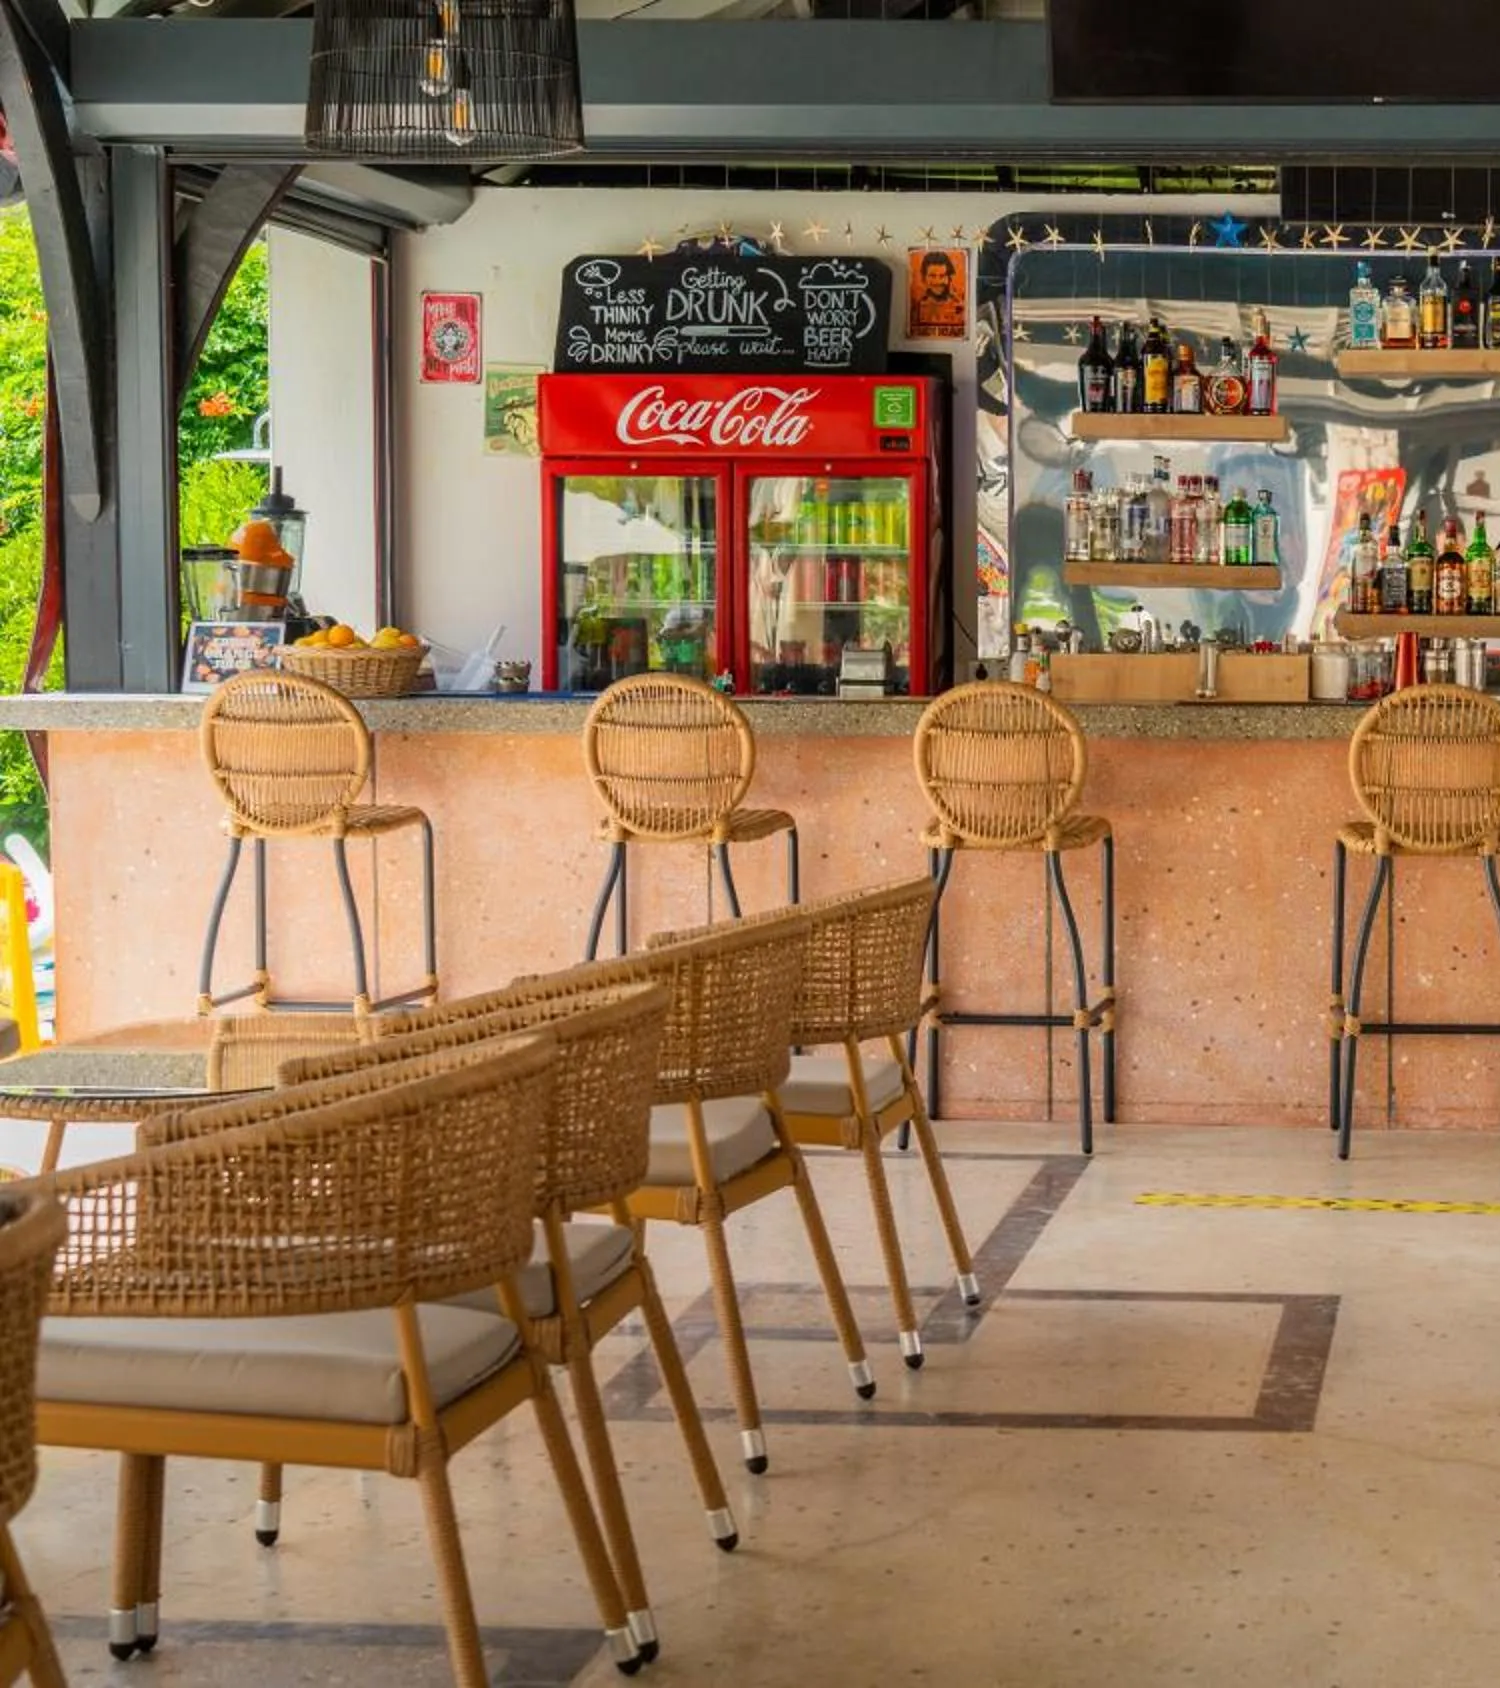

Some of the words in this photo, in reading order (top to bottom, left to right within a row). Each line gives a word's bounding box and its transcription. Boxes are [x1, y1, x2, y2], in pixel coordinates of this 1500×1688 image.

[682, 265, 746, 296] Getting
[607, 285, 646, 304] Less
[804, 289, 864, 310] DON'T
[590, 304, 655, 324] THINKY
[666, 287, 769, 325] DRUNK
[806, 309, 861, 327] WORRY
[605, 327, 646, 343] More
[803, 325, 853, 350] BEER
[591, 343, 657, 363] DRINKY
[677, 336, 730, 365] please
[616, 385, 822, 446] Coca-Cola
